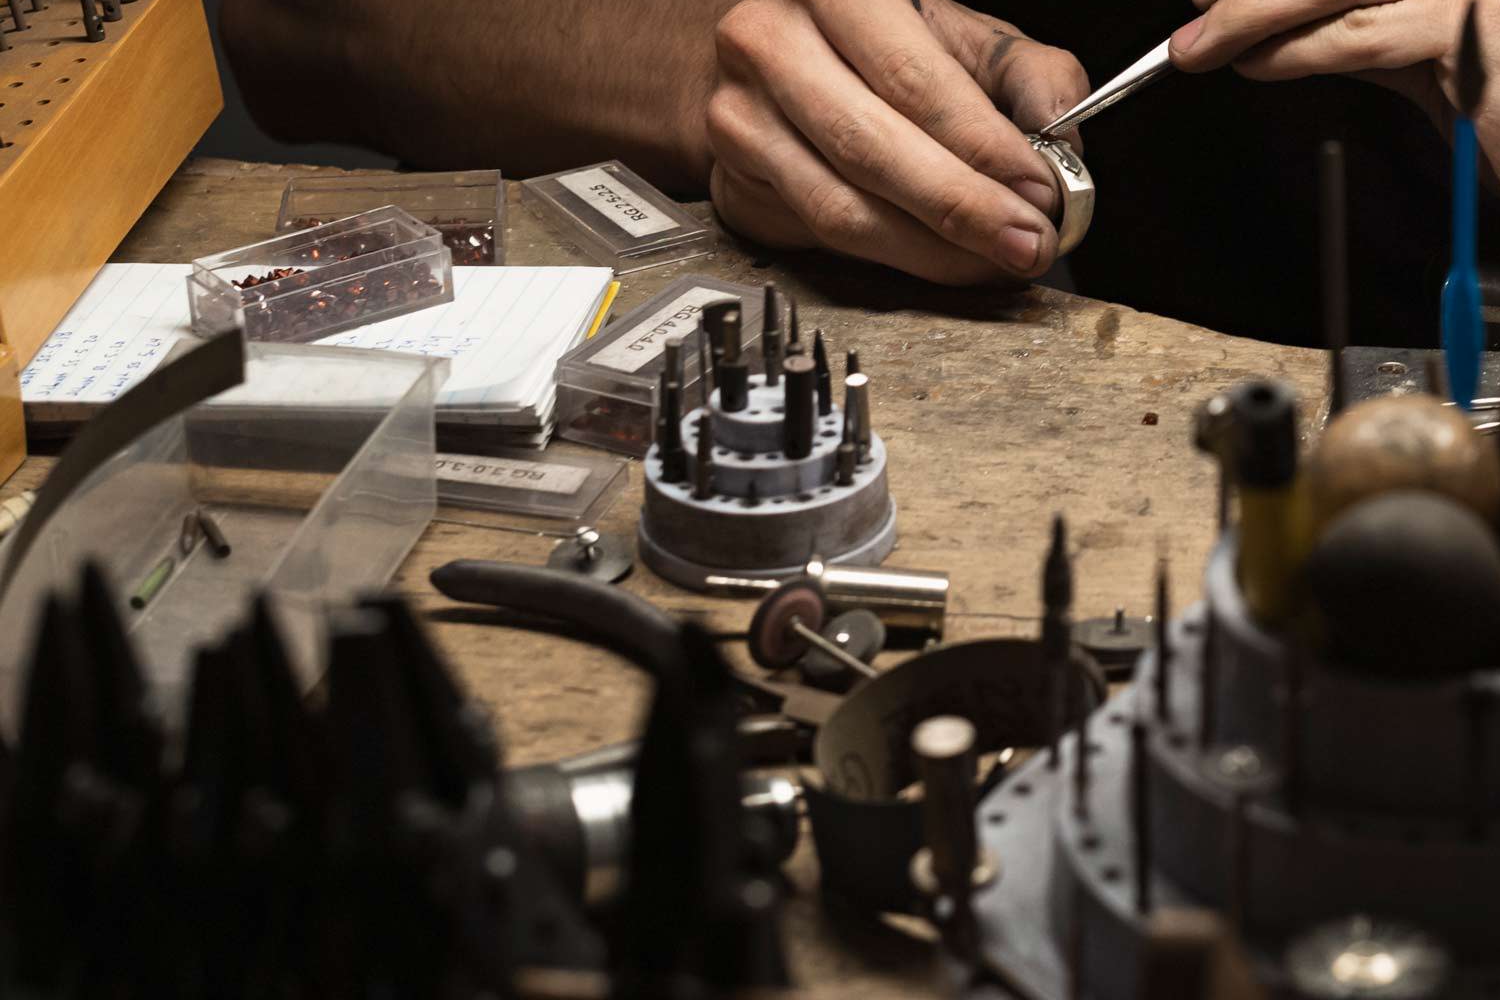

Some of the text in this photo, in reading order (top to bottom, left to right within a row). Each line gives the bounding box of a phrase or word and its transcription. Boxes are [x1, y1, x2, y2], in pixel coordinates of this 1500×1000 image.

[623, 208, 649, 221] RG
[674, 304, 704, 321] RG
[511, 468, 546, 481] RG
